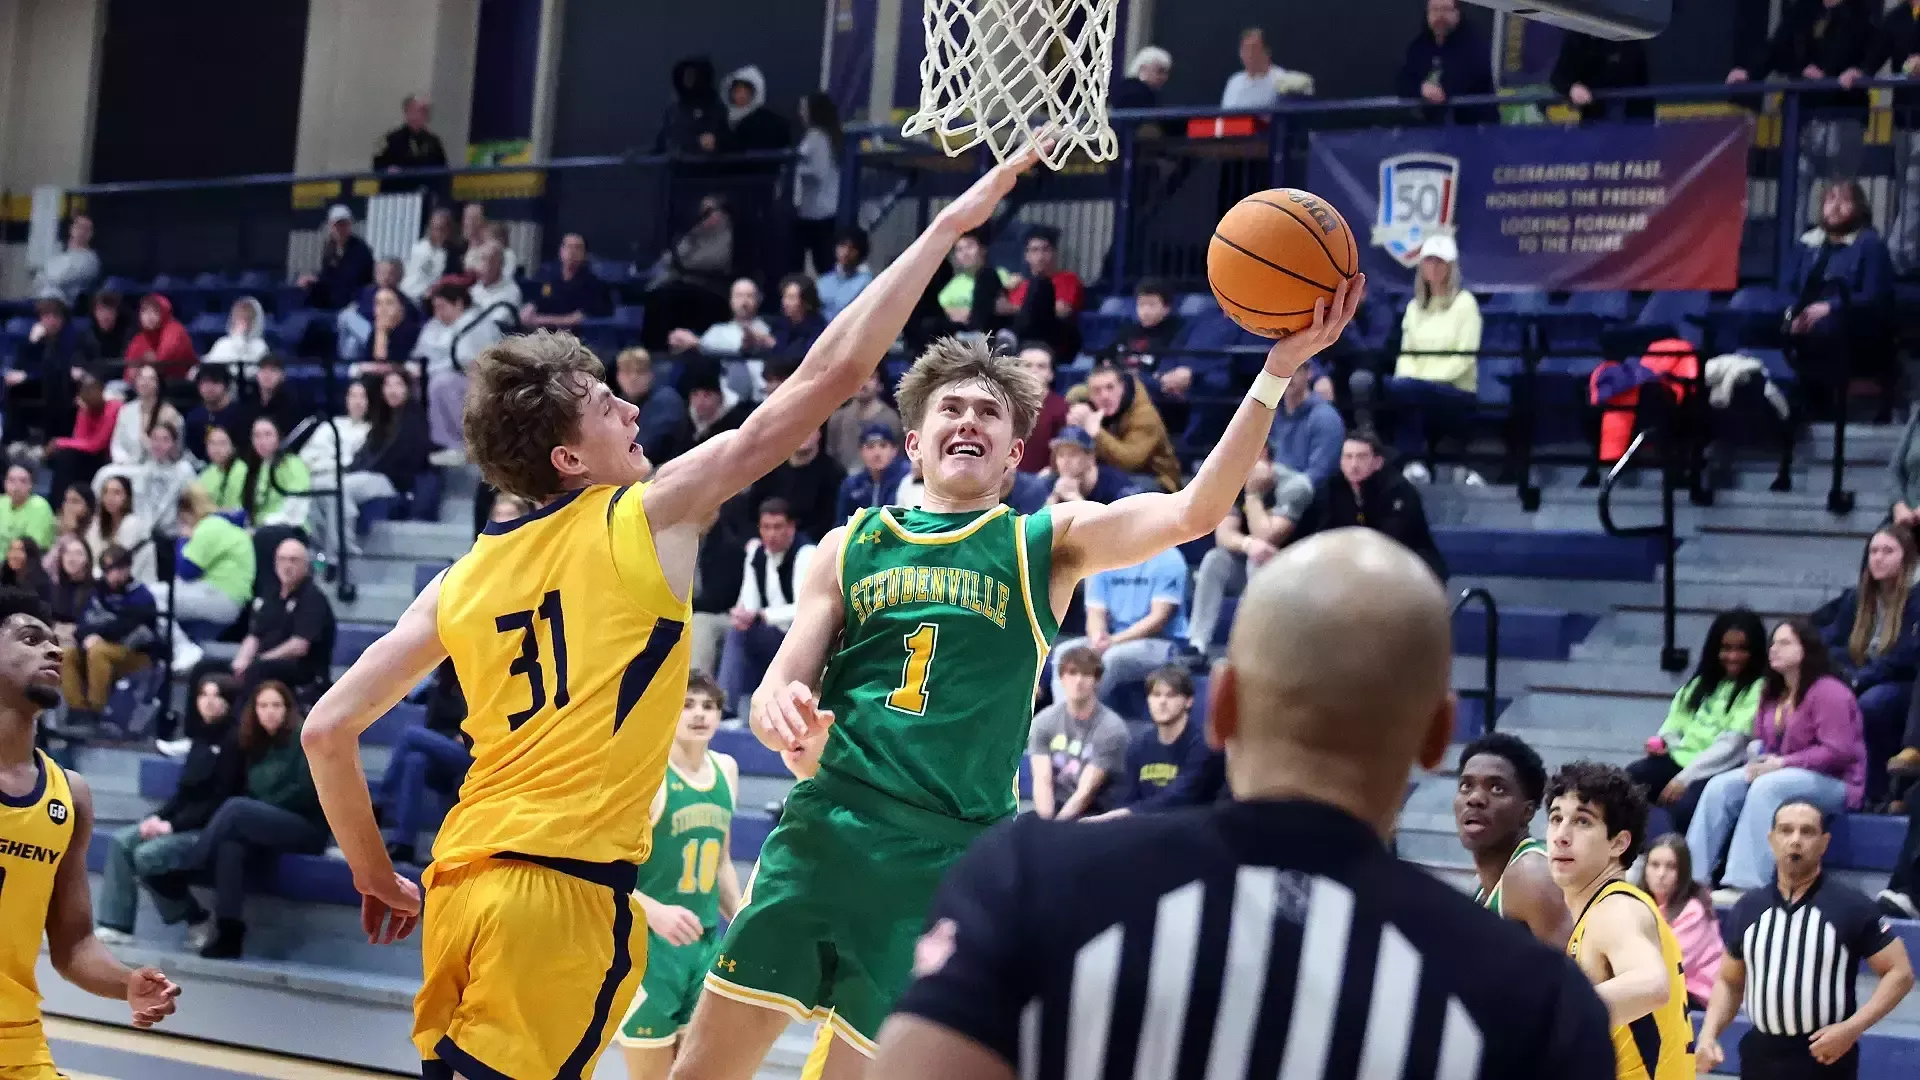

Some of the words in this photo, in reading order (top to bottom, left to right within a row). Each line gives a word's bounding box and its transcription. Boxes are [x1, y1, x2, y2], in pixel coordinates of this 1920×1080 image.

[1594, 161, 1621, 181] THE
[1396, 184, 1439, 222] 50
[1571, 187, 1598, 206] THE
[1501, 216, 1570, 236] LOOKING
[1518, 236, 1539, 253] TO
[1542, 235, 1567, 253] THE
[850, 566, 1010, 630] STEUBENVILLE
[494, 588, 571, 732] 31
[884, 622, 940, 717] 1
[49, 803, 66, 820] GB
[677, 838, 721, 893] 10
